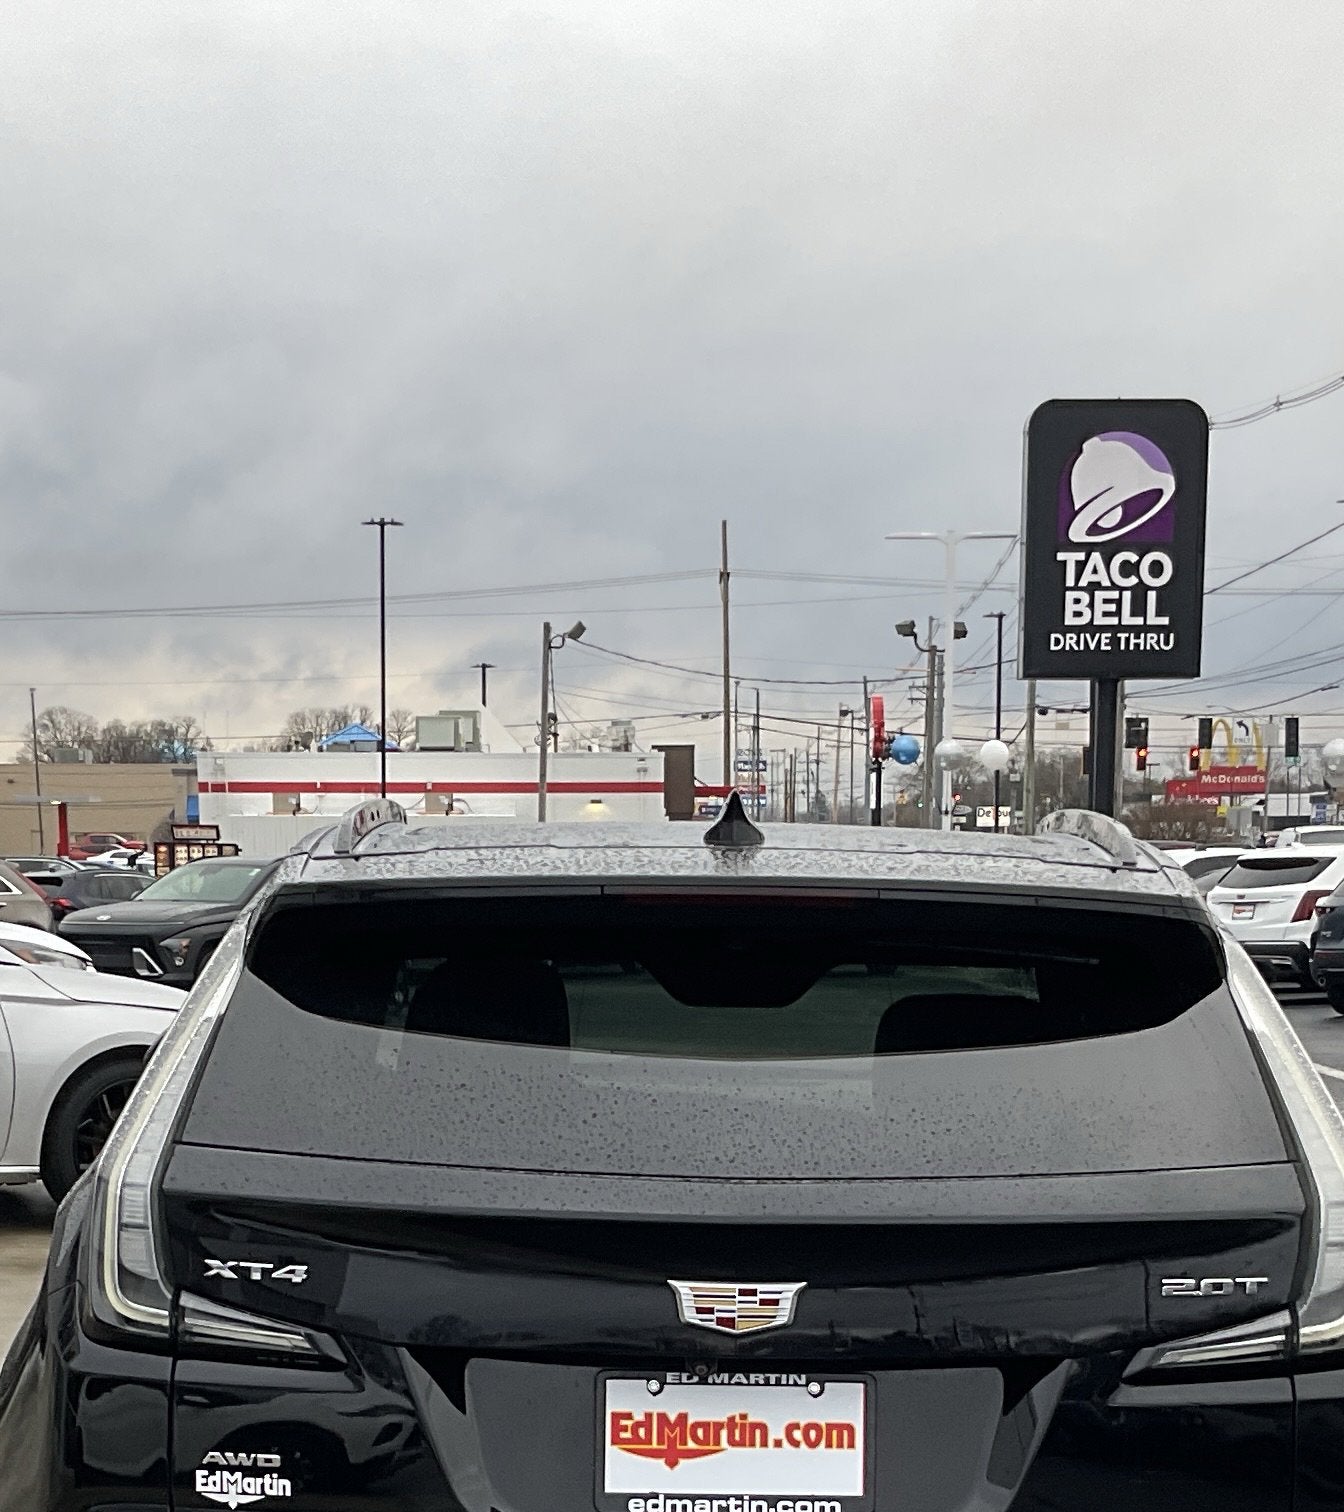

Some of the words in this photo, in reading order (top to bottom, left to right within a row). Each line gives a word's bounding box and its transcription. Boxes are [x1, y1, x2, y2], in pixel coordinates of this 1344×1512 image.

[1056, 551, 1173, 587] TACO
[1064, 590, 1170, 626] BELL
[1050, 633, 1112, 651] DRIVE
[1117, 633, 1175, 651] THRU
[203, 1259, 308, 1282] XT4
[666, 1372, 698, 1384] ED
[708, 1373, 806, 1385] MARTIN
[610, 1411, 856, 1449] EdMartin.com
[202, 1451, 281, 1467] AWD
[196, 1469, 291, 1497] EdMartin
